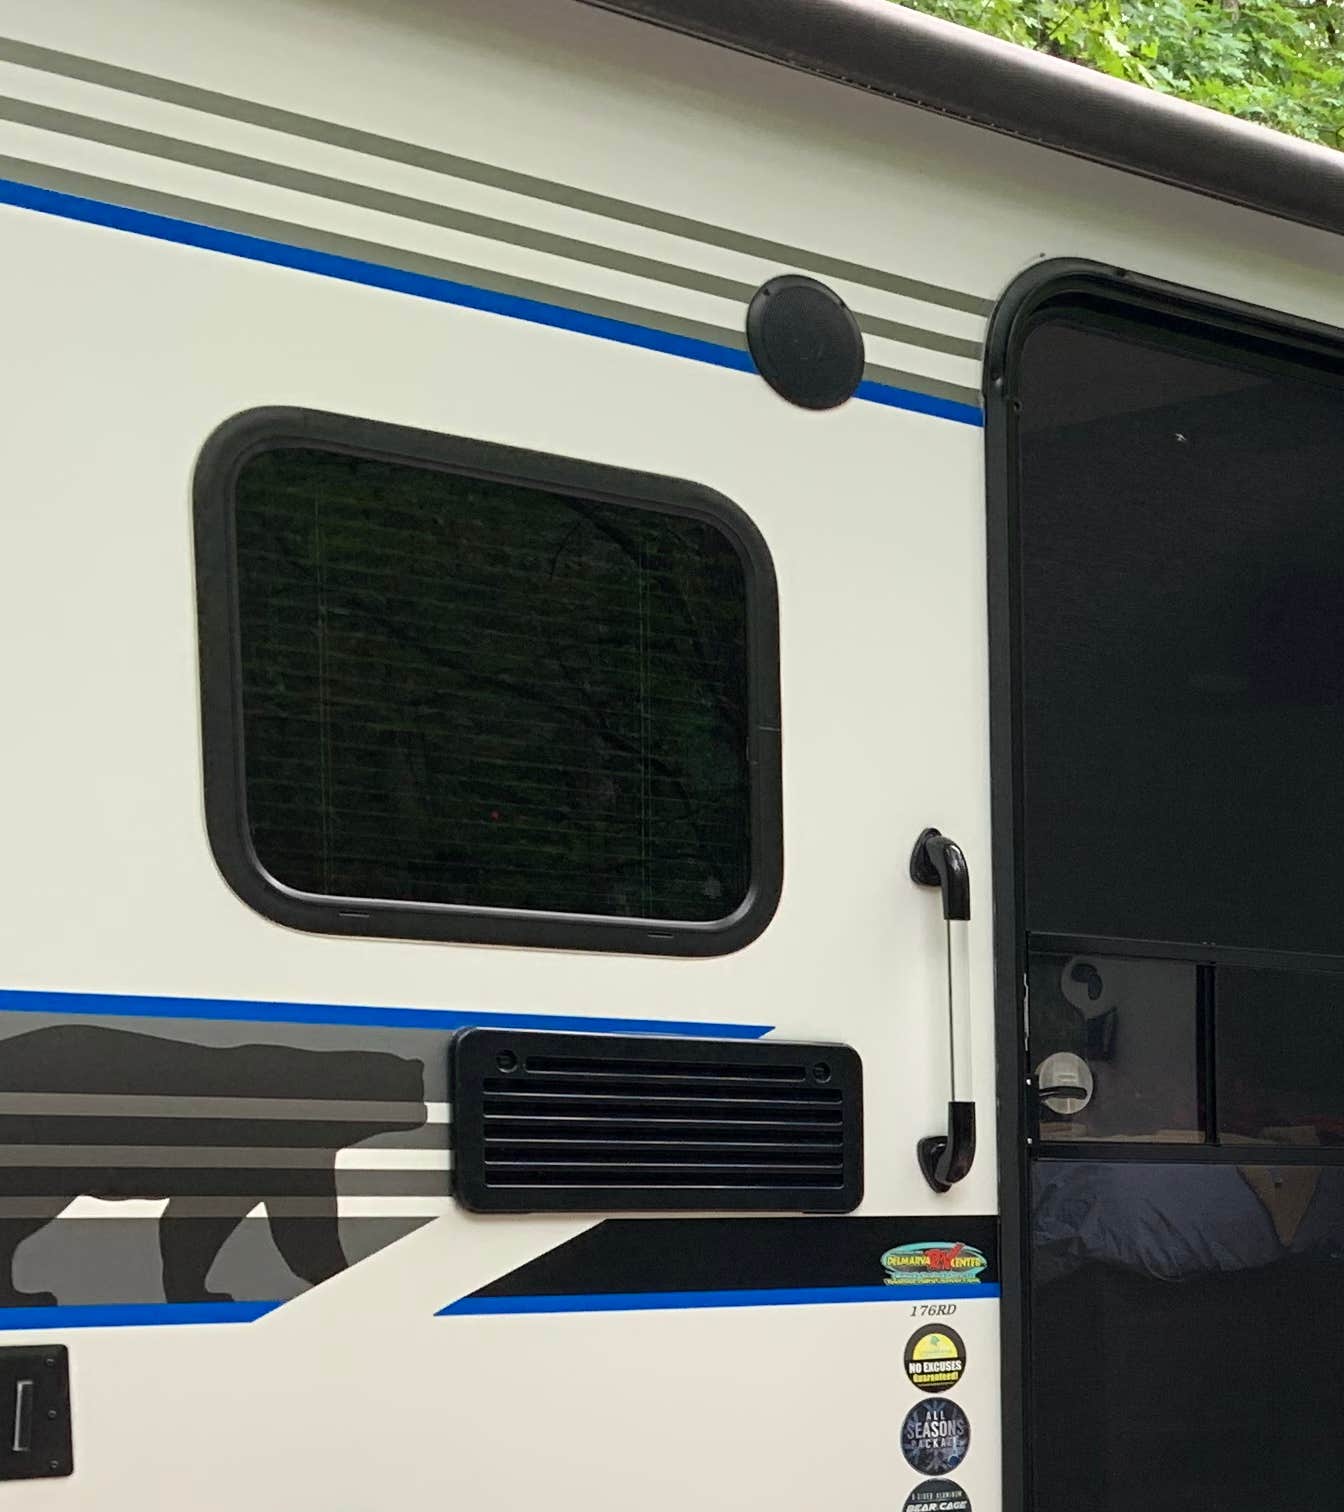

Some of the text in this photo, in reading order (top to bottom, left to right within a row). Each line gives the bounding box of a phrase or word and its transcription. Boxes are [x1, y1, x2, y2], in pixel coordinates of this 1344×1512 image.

[910, 1304, 957, 1317] 176RD
[908, 1360, 962, 1374] NO EXCUSES
[926, 1410, 945, 1421] ALL
[907, 1420, 965, 1439] SEASONS
[906, 1501, 968, 1512] BEAR CAGE
